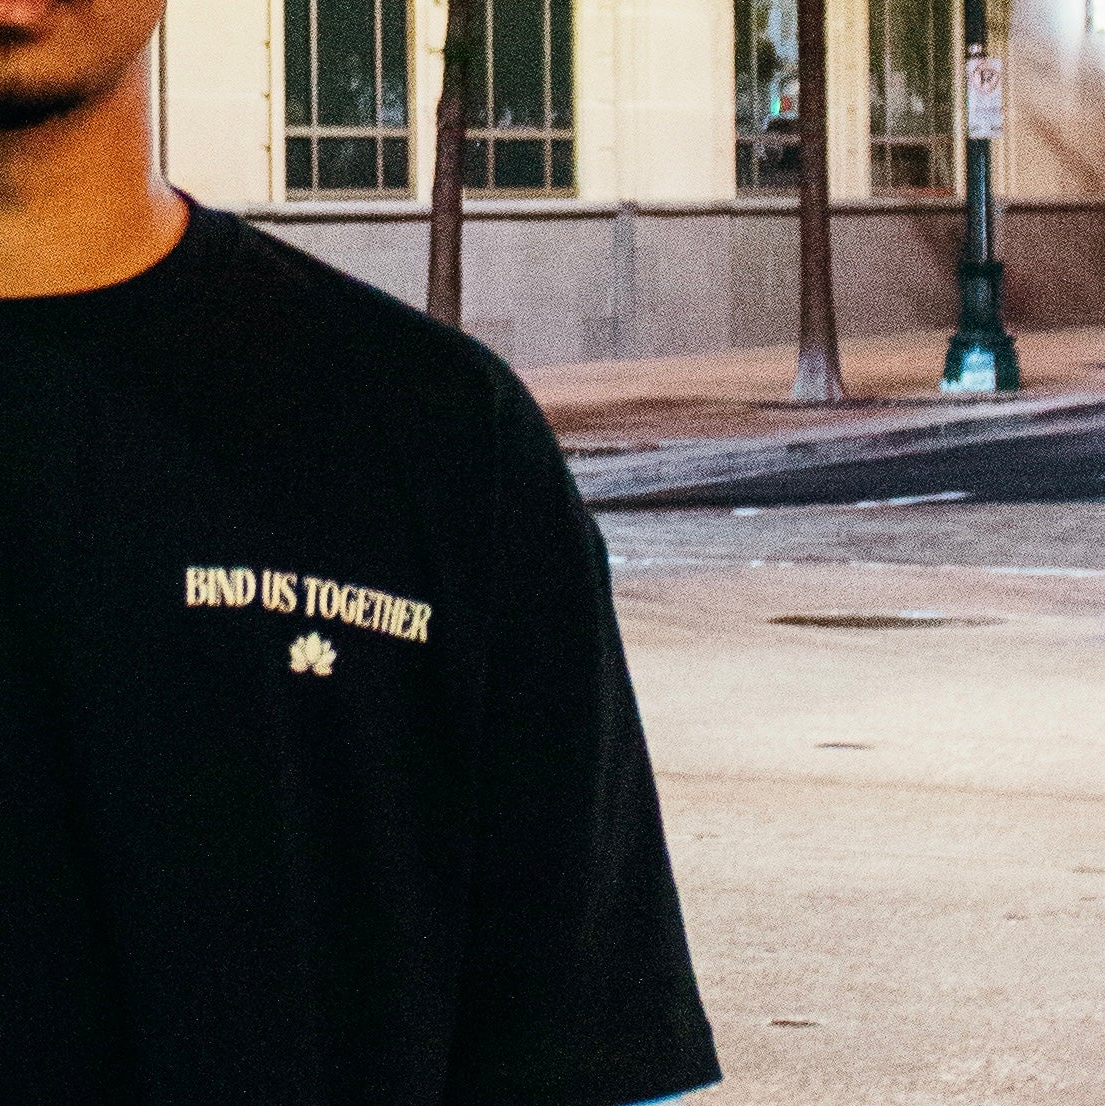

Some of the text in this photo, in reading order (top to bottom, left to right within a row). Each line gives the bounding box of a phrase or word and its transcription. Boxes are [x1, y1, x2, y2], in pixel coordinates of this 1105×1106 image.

[186, 566, 432, 643] BIND US TOGETHER
